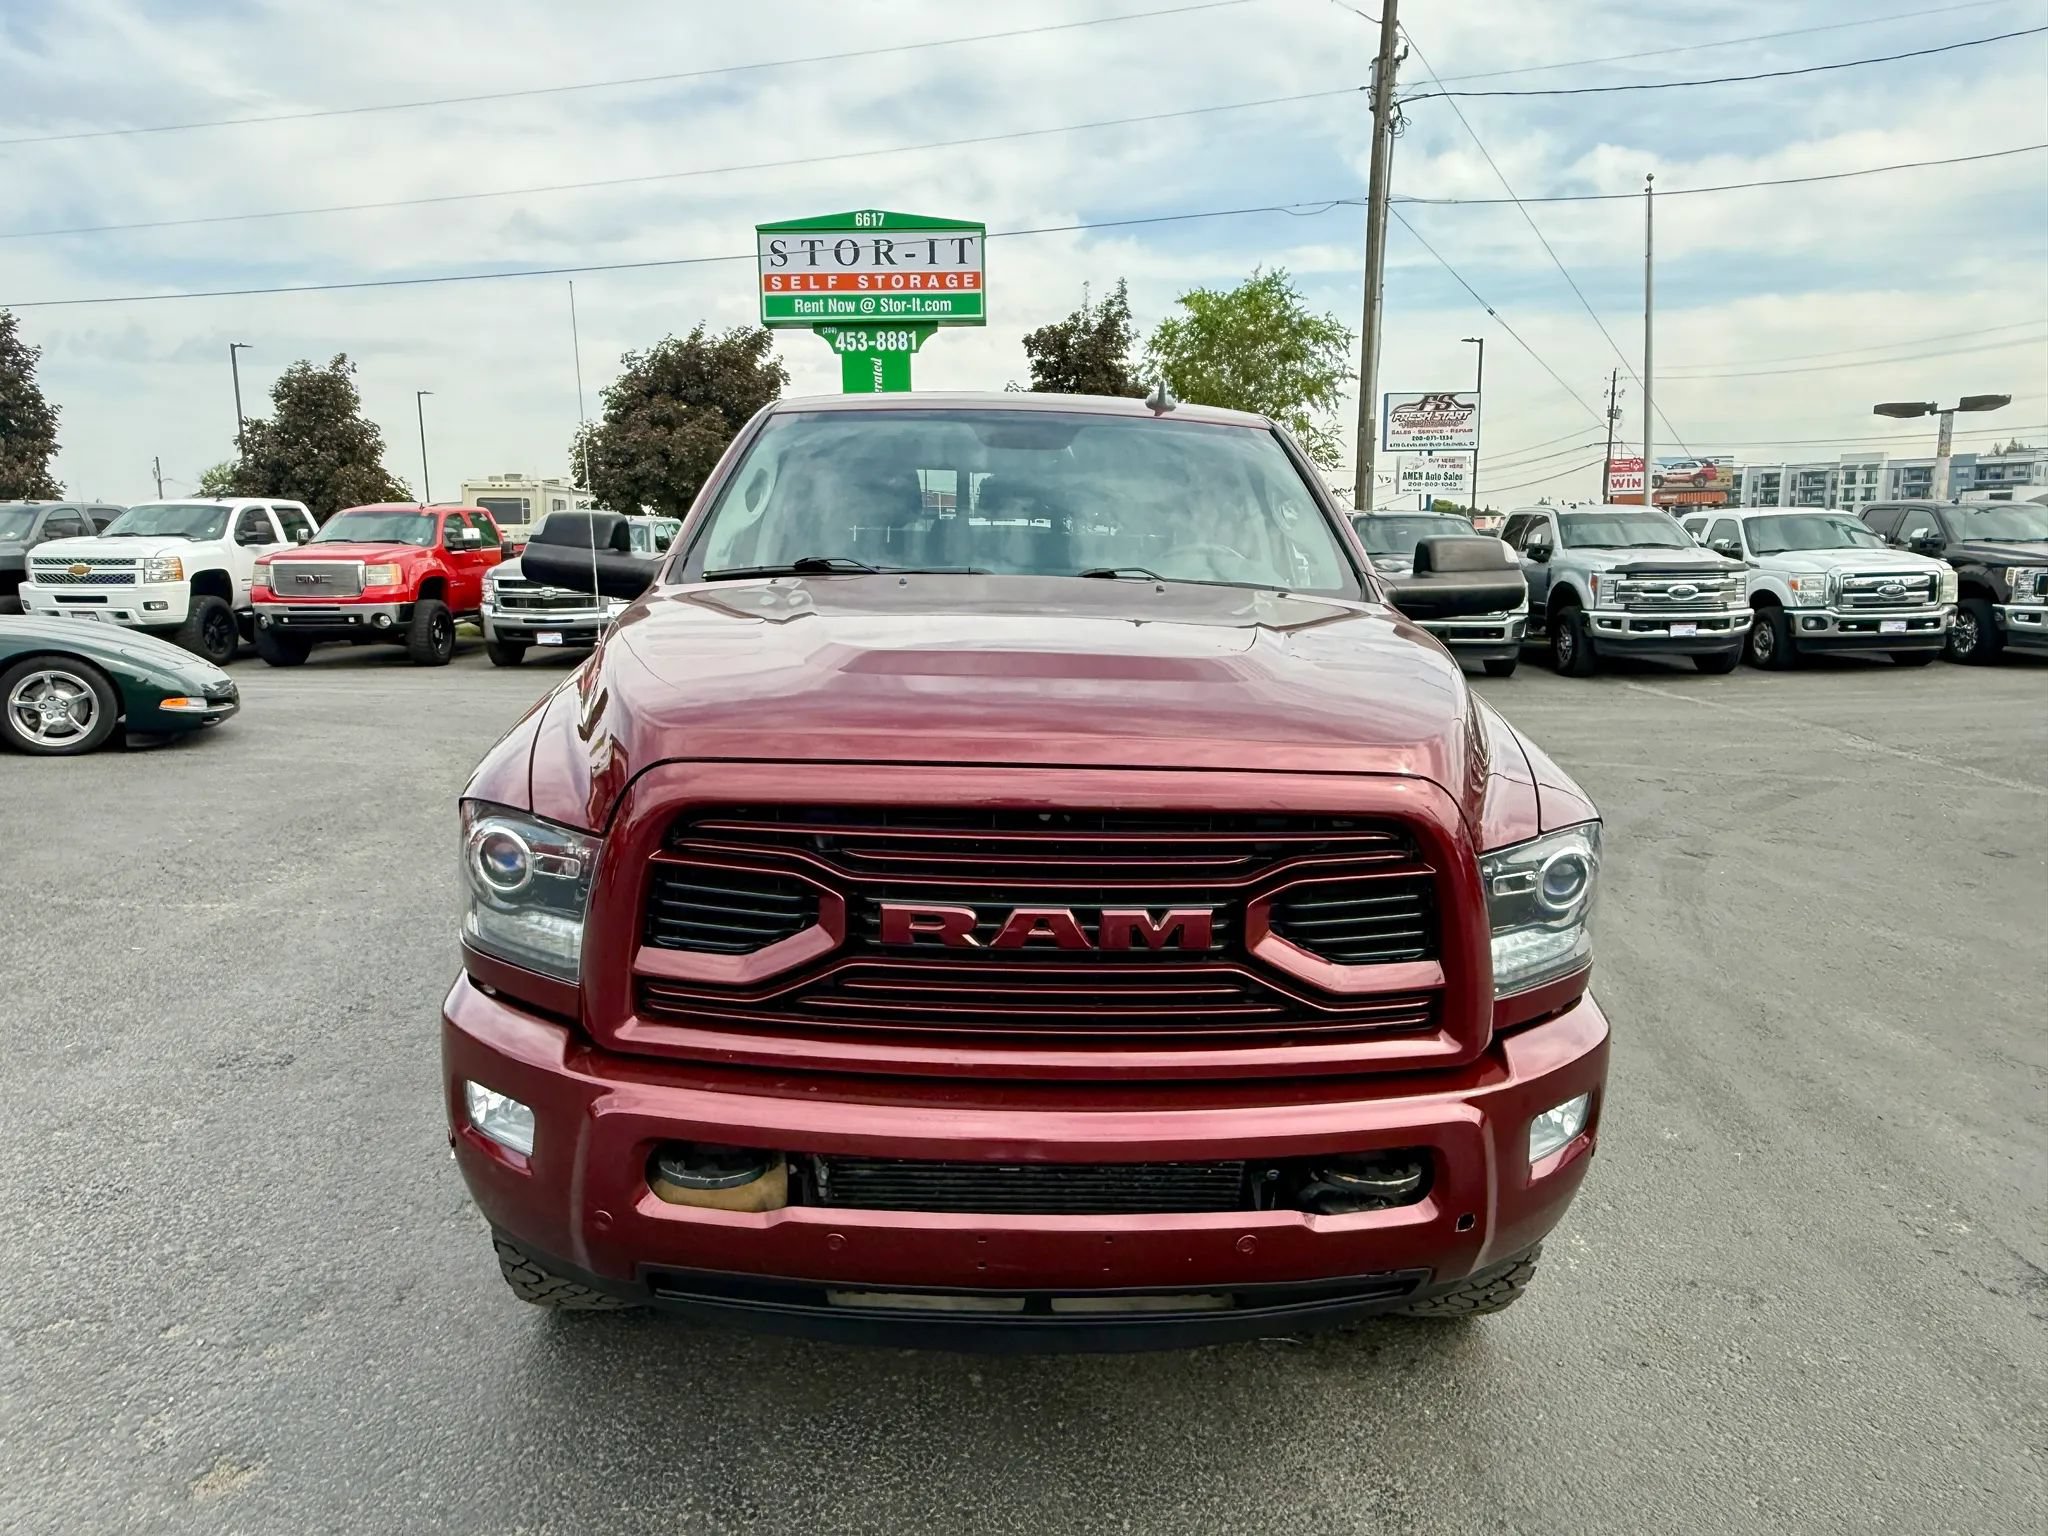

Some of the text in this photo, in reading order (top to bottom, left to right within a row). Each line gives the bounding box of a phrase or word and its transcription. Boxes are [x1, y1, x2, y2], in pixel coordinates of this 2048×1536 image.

[855, 213, 885, 227] 6617
[769, 238, 974, 267] STOR-IT
[771, 274, 974, 289] SELF STORAGE
[794, 297, 952, 313] Rent Now @ Stor-It.com
[835, 330, 917, 351] 453-8881
[1391, 410, 1473, 422] FRESH START
[1402, 472, 1463, 480] AMEN Auto Sales
[1611, 478, 1641, 488] WIN
[880, 901, 1213, 950] RAM
